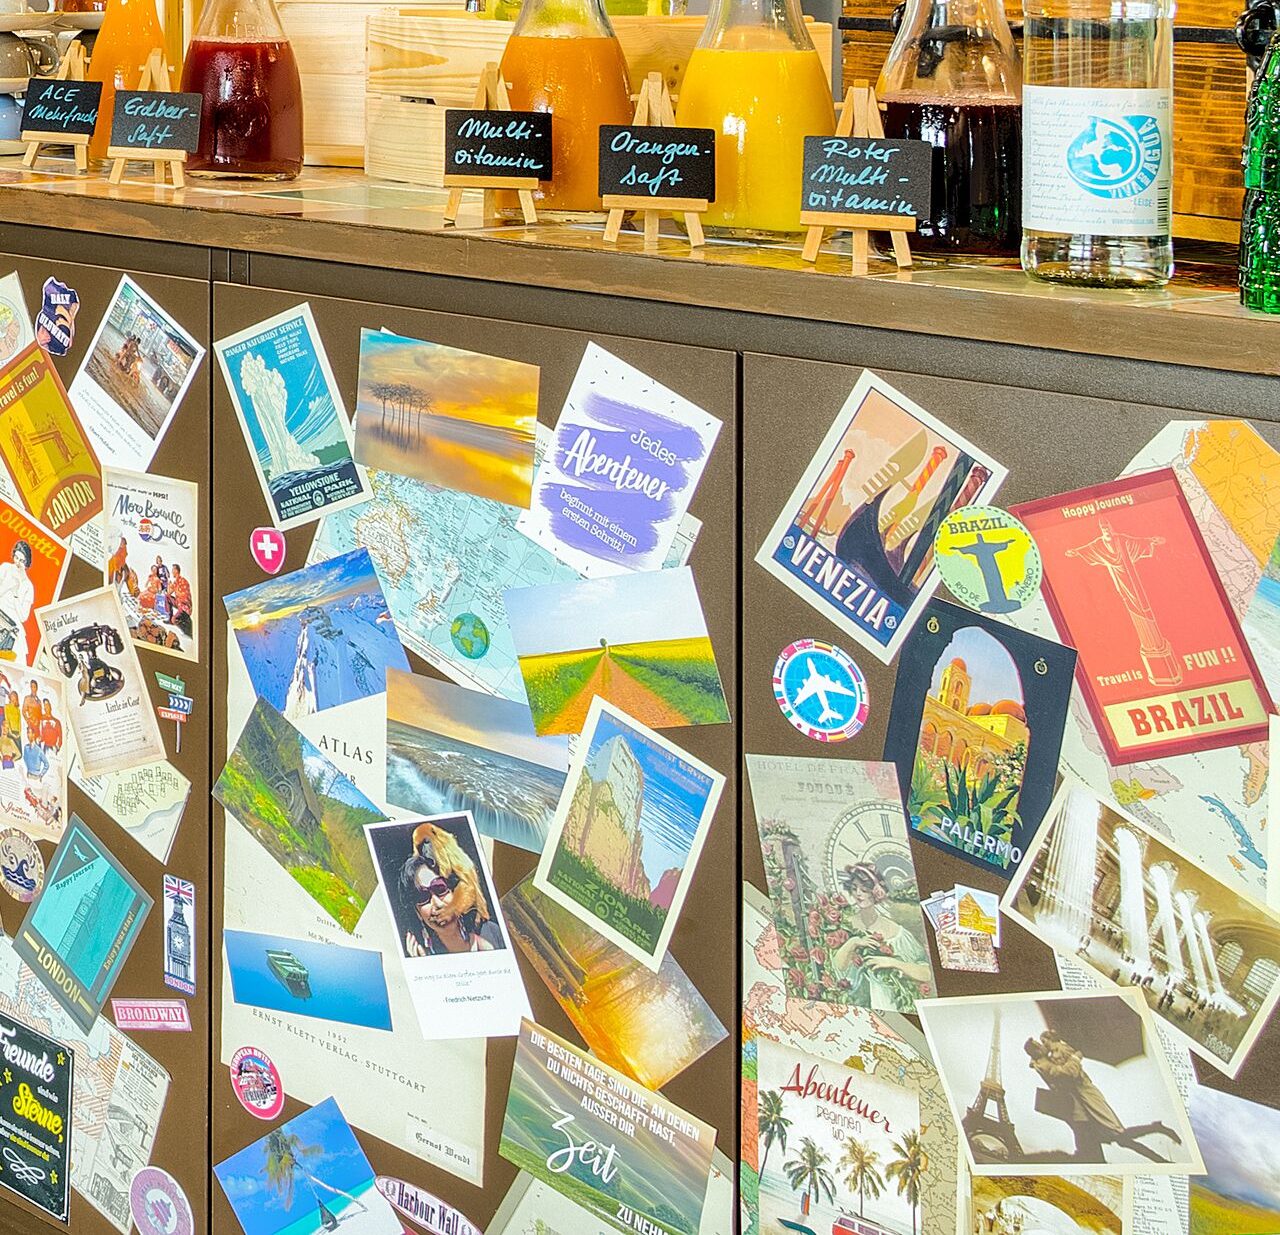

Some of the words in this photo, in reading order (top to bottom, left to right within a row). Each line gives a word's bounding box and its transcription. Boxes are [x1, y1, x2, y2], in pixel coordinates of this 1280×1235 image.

[40, 87, 80, 102] ACE
[455, 148, 543, 170] vitamin
[822, 140, 900, 163] Roter
[1138, 118, 1161, 173] AGUA
[810, 164, 889, 186] Multi
[808, 188, 918, 217] vitamin
[15, 383, 24, 395] is
[22, 367, 39, 390] fun!
[563, 430, 670, 502] Abenteuer
[631, 429, 679, 466] Jedes
[289, 472, 340, 496] YELLOWSTONE
[46, 480, 96, 530] LONDON
[559, 488, 593, 517] beginnt
[592, 507, 608, 527] mit
[606, 517, 637, 547] einem
[1062, 500, 1095, 519] Happy
[1095, 493, 1133, 514] Journey
[562, 505, 592, 531] ersten
[590, 522, 625, 554] Schritt!
[948, 517, 1008, 535] BRAZIL
[792, 534, 894, 631] VENEZIA
[1096, 673, 1131, 690] Travel
[1131, 669, 1143, 682] is
[1185, 649, 1219, 671] FUN
[1127, 692, 1244, 738] BRAZIL
[319, 733, 374, 766] ATLAS
[941, 818, 1022, 865] PALERMO
[585, 879, 628, 915] ZION
[36, 948, 82, 1004] LONDON
[164, 975, 195, 994] LONDON
[116, 1005, 186, 1022] BROADWAY
[252, 1008, 283, 1030] ERNST
[285, 1021, 316, 1042] KLETT
[316, 1035, 359, 1065] VERLAG
[364, 1059, 427, 1094] STUTTGART
[326, 1030, 349, 1045] 1952
[530, 1031, 546, 1050] DIE
[547, 1040, 582, 1071] BESTEN
[584, 1061, 606, 1086] TAGE
[608, 1076, 630, 1099] SIND
[651, 1103, 665, 1120] AN
[667, 1112, 700, 1141] DENEN
[546, 1057, 560, 1075] DU
[561, 1065, 594, 1097] NICHTS
[595, 1086, 648, 1127] GESCHAFFT
[649, 1120, 676, 1146] HAST,
[780, 1062, 893, 1135] Abenteuer
[12, 1082, 64, 1144] Sterne,
[580, 1095, 618, 1127] AUSSER
[619, 1119, 635, 1137] DIR
[546, 1105, 621, 1183] Zeit
[397, 1182, 436, 1229] Harbour
[435, 1204, 460, 1234] Wall
